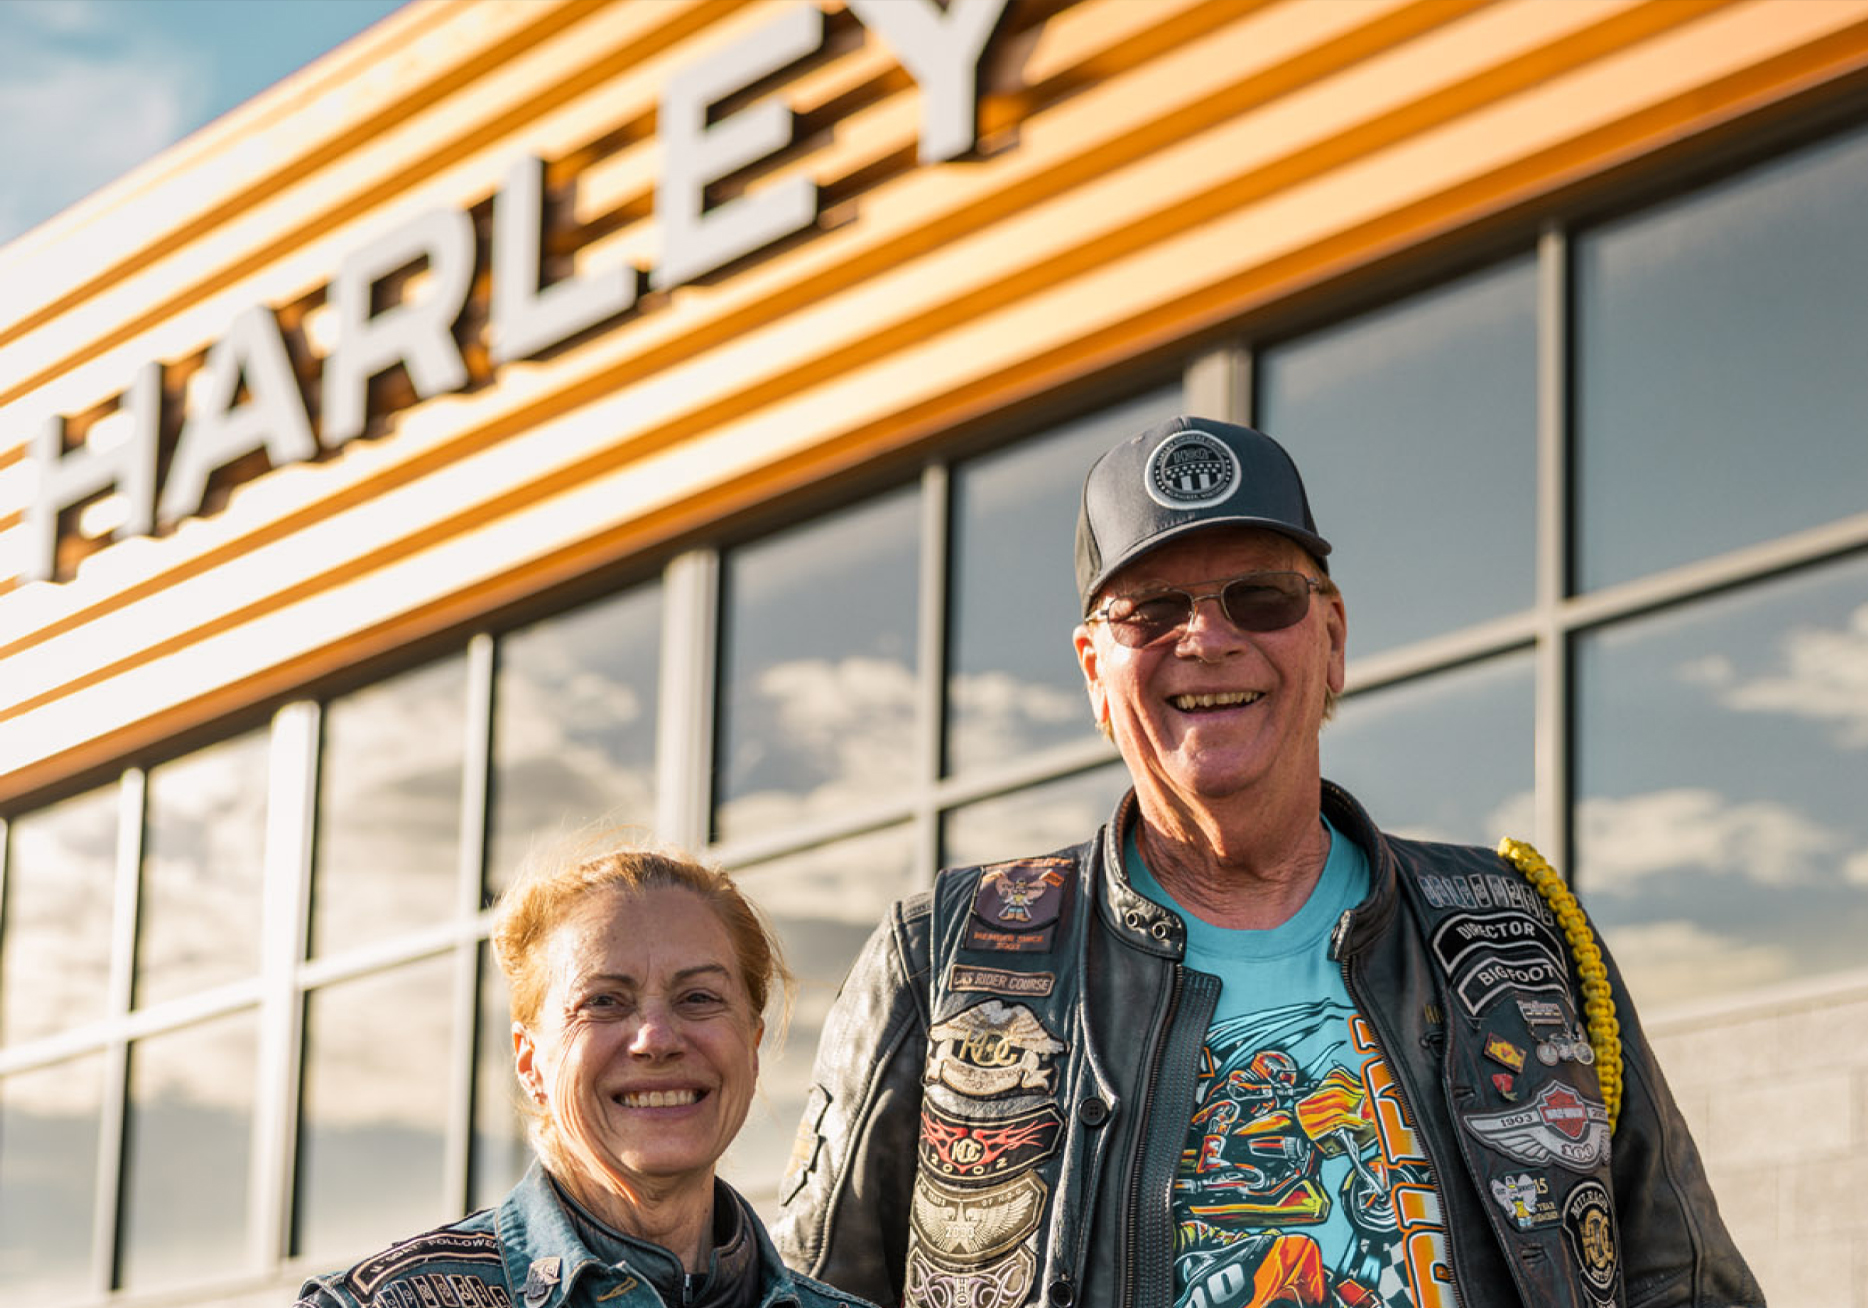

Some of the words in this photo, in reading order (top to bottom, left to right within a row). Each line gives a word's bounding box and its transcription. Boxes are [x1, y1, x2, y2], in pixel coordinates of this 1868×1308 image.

[20, 0, 1003, 582] HARLEY
[1456, 921, 1535, 940] DIRECTOR
[976, 973, 1008, 988] RIDER
[1009, 978, 1049, 991] COURSE
[1478, 964, 1553, 986] BIGFOOT
[1501, 1113, 1532, 1127] 1903
[1533, 1178, 1548, 1194] 15
